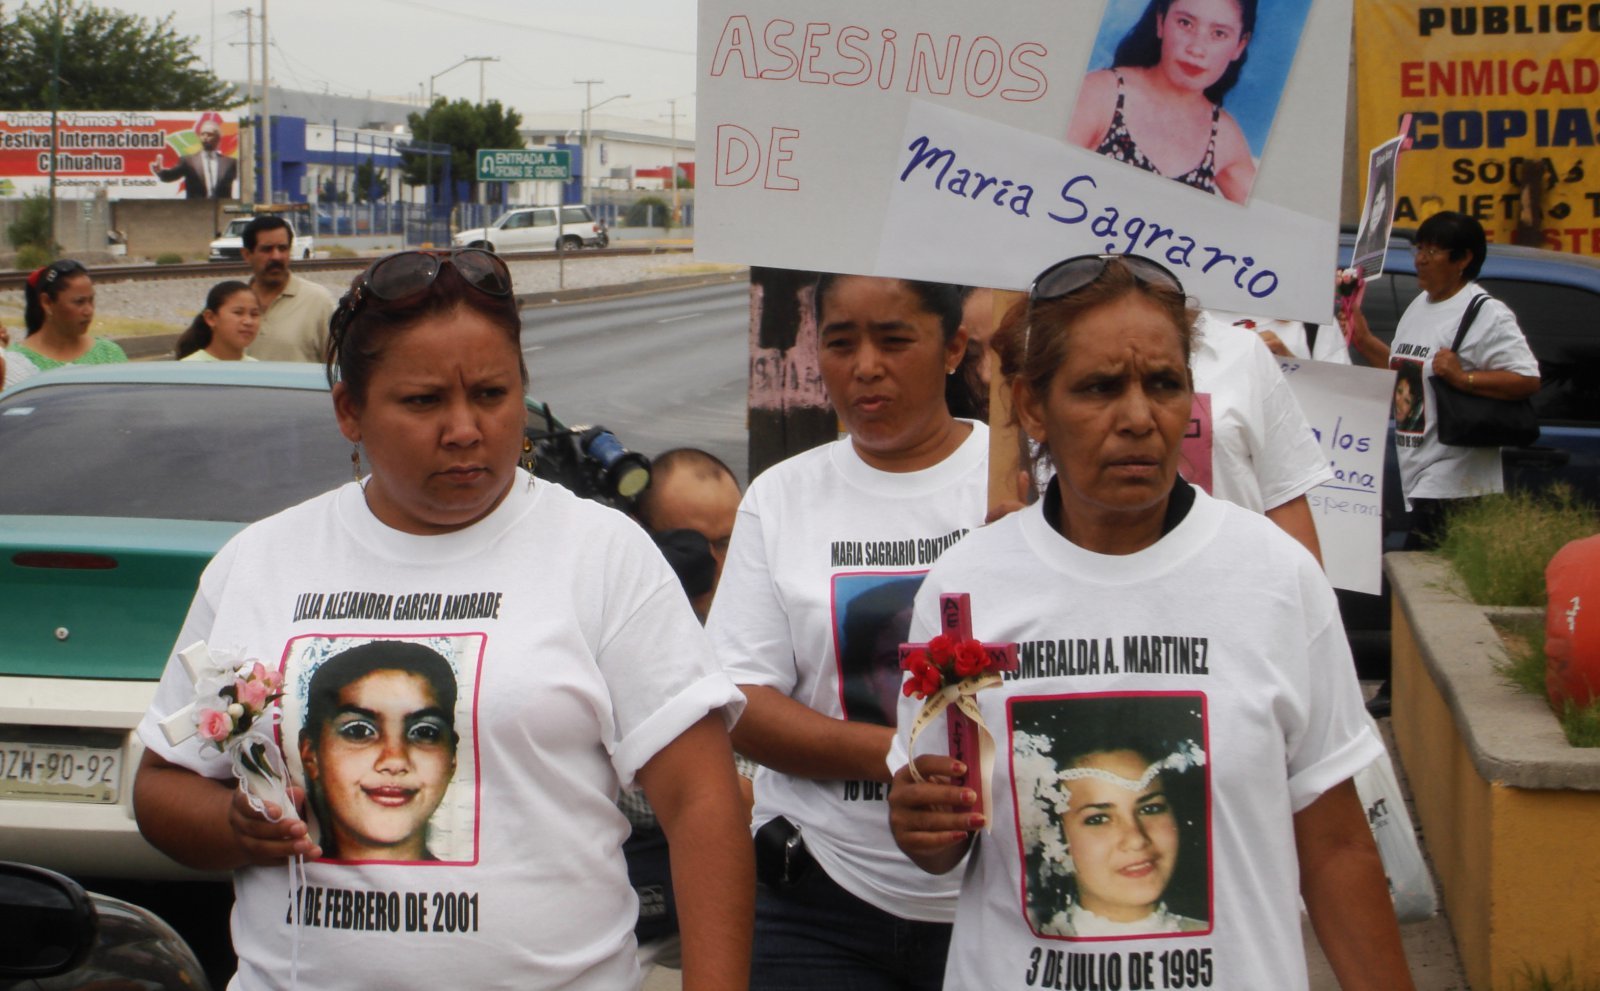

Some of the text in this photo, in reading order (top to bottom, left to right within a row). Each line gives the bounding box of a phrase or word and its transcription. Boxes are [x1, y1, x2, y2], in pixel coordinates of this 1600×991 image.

[1401, 58, 1600, 98] ENMICAD
[65, 113, 117, 126] Vamos
[120, 112, 156, 126] bien
[1398, 108, 1600, 149] COPIA
[0, 130, 164, 148] Festiva Internacional
[39, 153, 122, 171] Cihuahua
[496, 153, 558, 165] ENTRADA A
[715, 124, 800, 191] DE
[1048, 175, 1279, 298] Sagrario
[1330, 461, 1375, 488] ana
[831, 541, 863, 567] MARIA
[865, 539, 916, 566] SAGRARIO
[293, 591, 502, 623] LILIA ALEJANDRA GARCIA ANDRADE
[1103, 637, 1119, 674] A.
[1123, 635, 1209, 675] MARTINEZ
[305, 886, 322, 927] DE
[324, 887, 400, 932] FEBRERO
[405, 891, 428, 932] DE
[432, 891, 479, 932] 2001
[1026, 946, 1213, 991] 3 DE JULIO DE 1995
